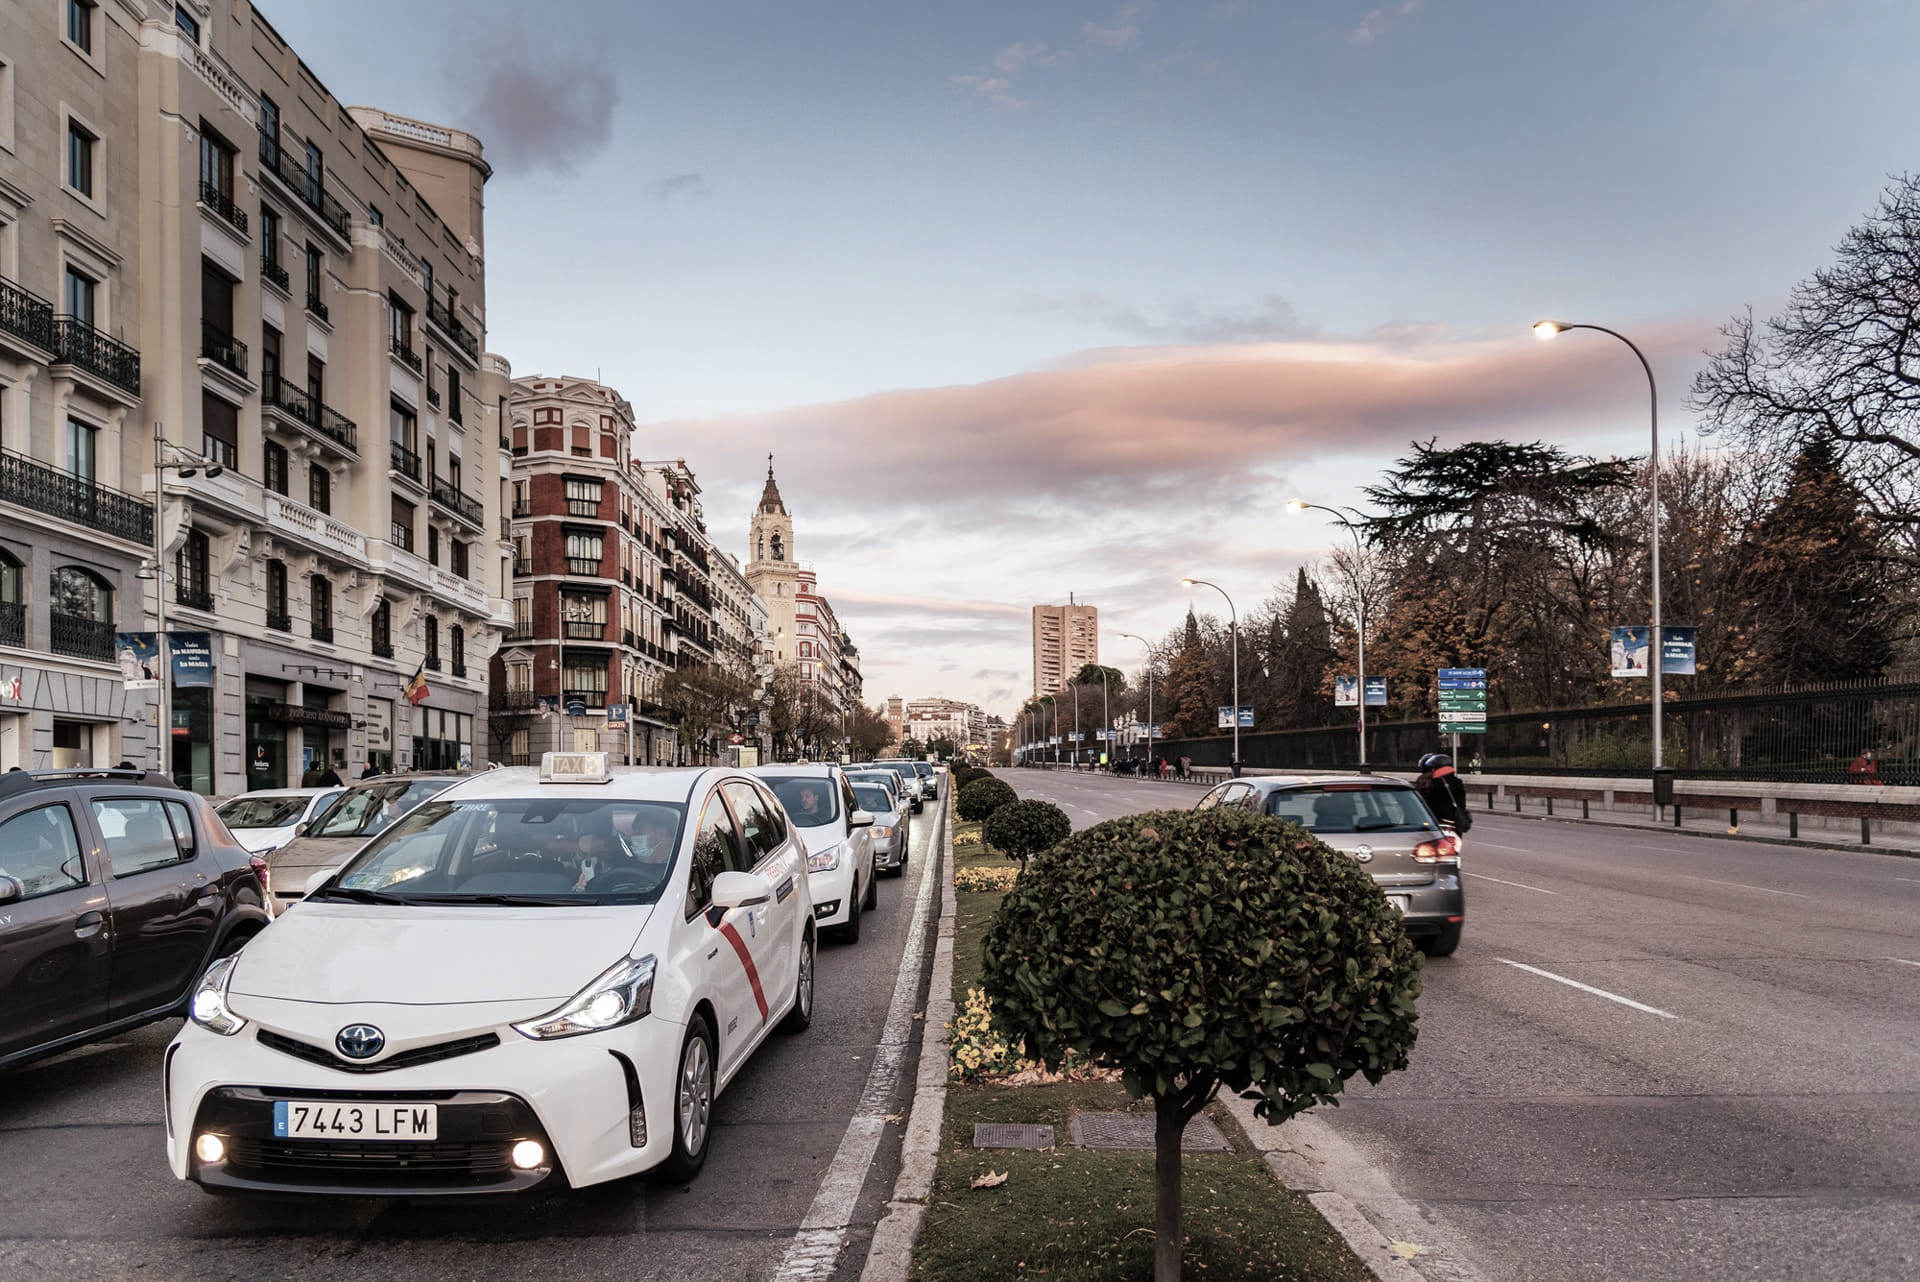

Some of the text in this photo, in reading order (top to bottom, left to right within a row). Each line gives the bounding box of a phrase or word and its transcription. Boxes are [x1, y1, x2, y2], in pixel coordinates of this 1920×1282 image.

[278, 1122, 285, 1130] E
[294, 1107, 428, 1134] 7443 LFM
